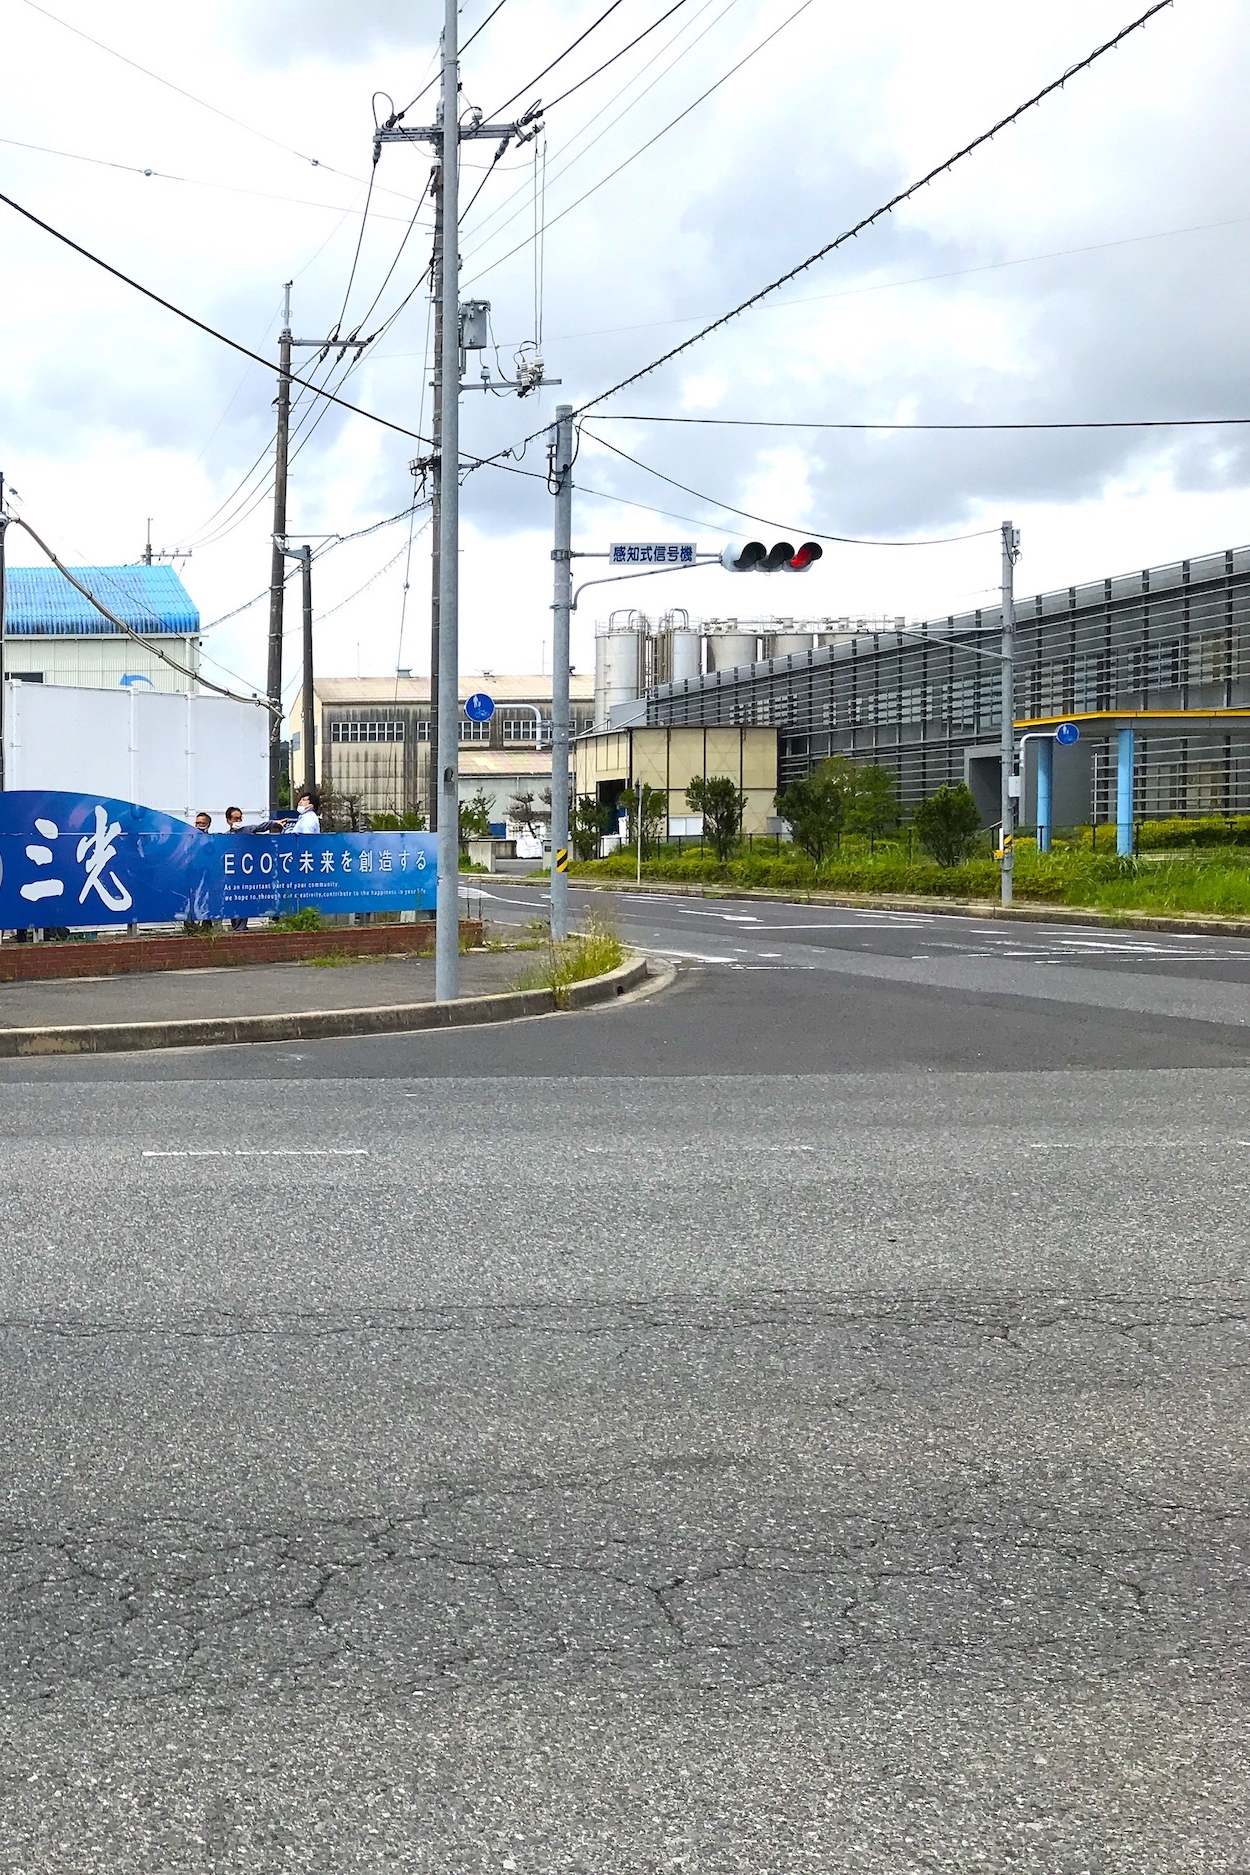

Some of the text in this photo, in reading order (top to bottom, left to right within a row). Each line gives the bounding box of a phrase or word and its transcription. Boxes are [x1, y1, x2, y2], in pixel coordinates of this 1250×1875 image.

[612, 546, 694, 563] 感知式信号機
[19, 804, 133, 912] 三光
[224, 850, 427, 875] ECOで未来を創造する
[241, 883, 271, 891] important
[294, 882, 307, 890] your
[234, 894, 248, 902] hope
[371, 889, 397, 897] happiness
